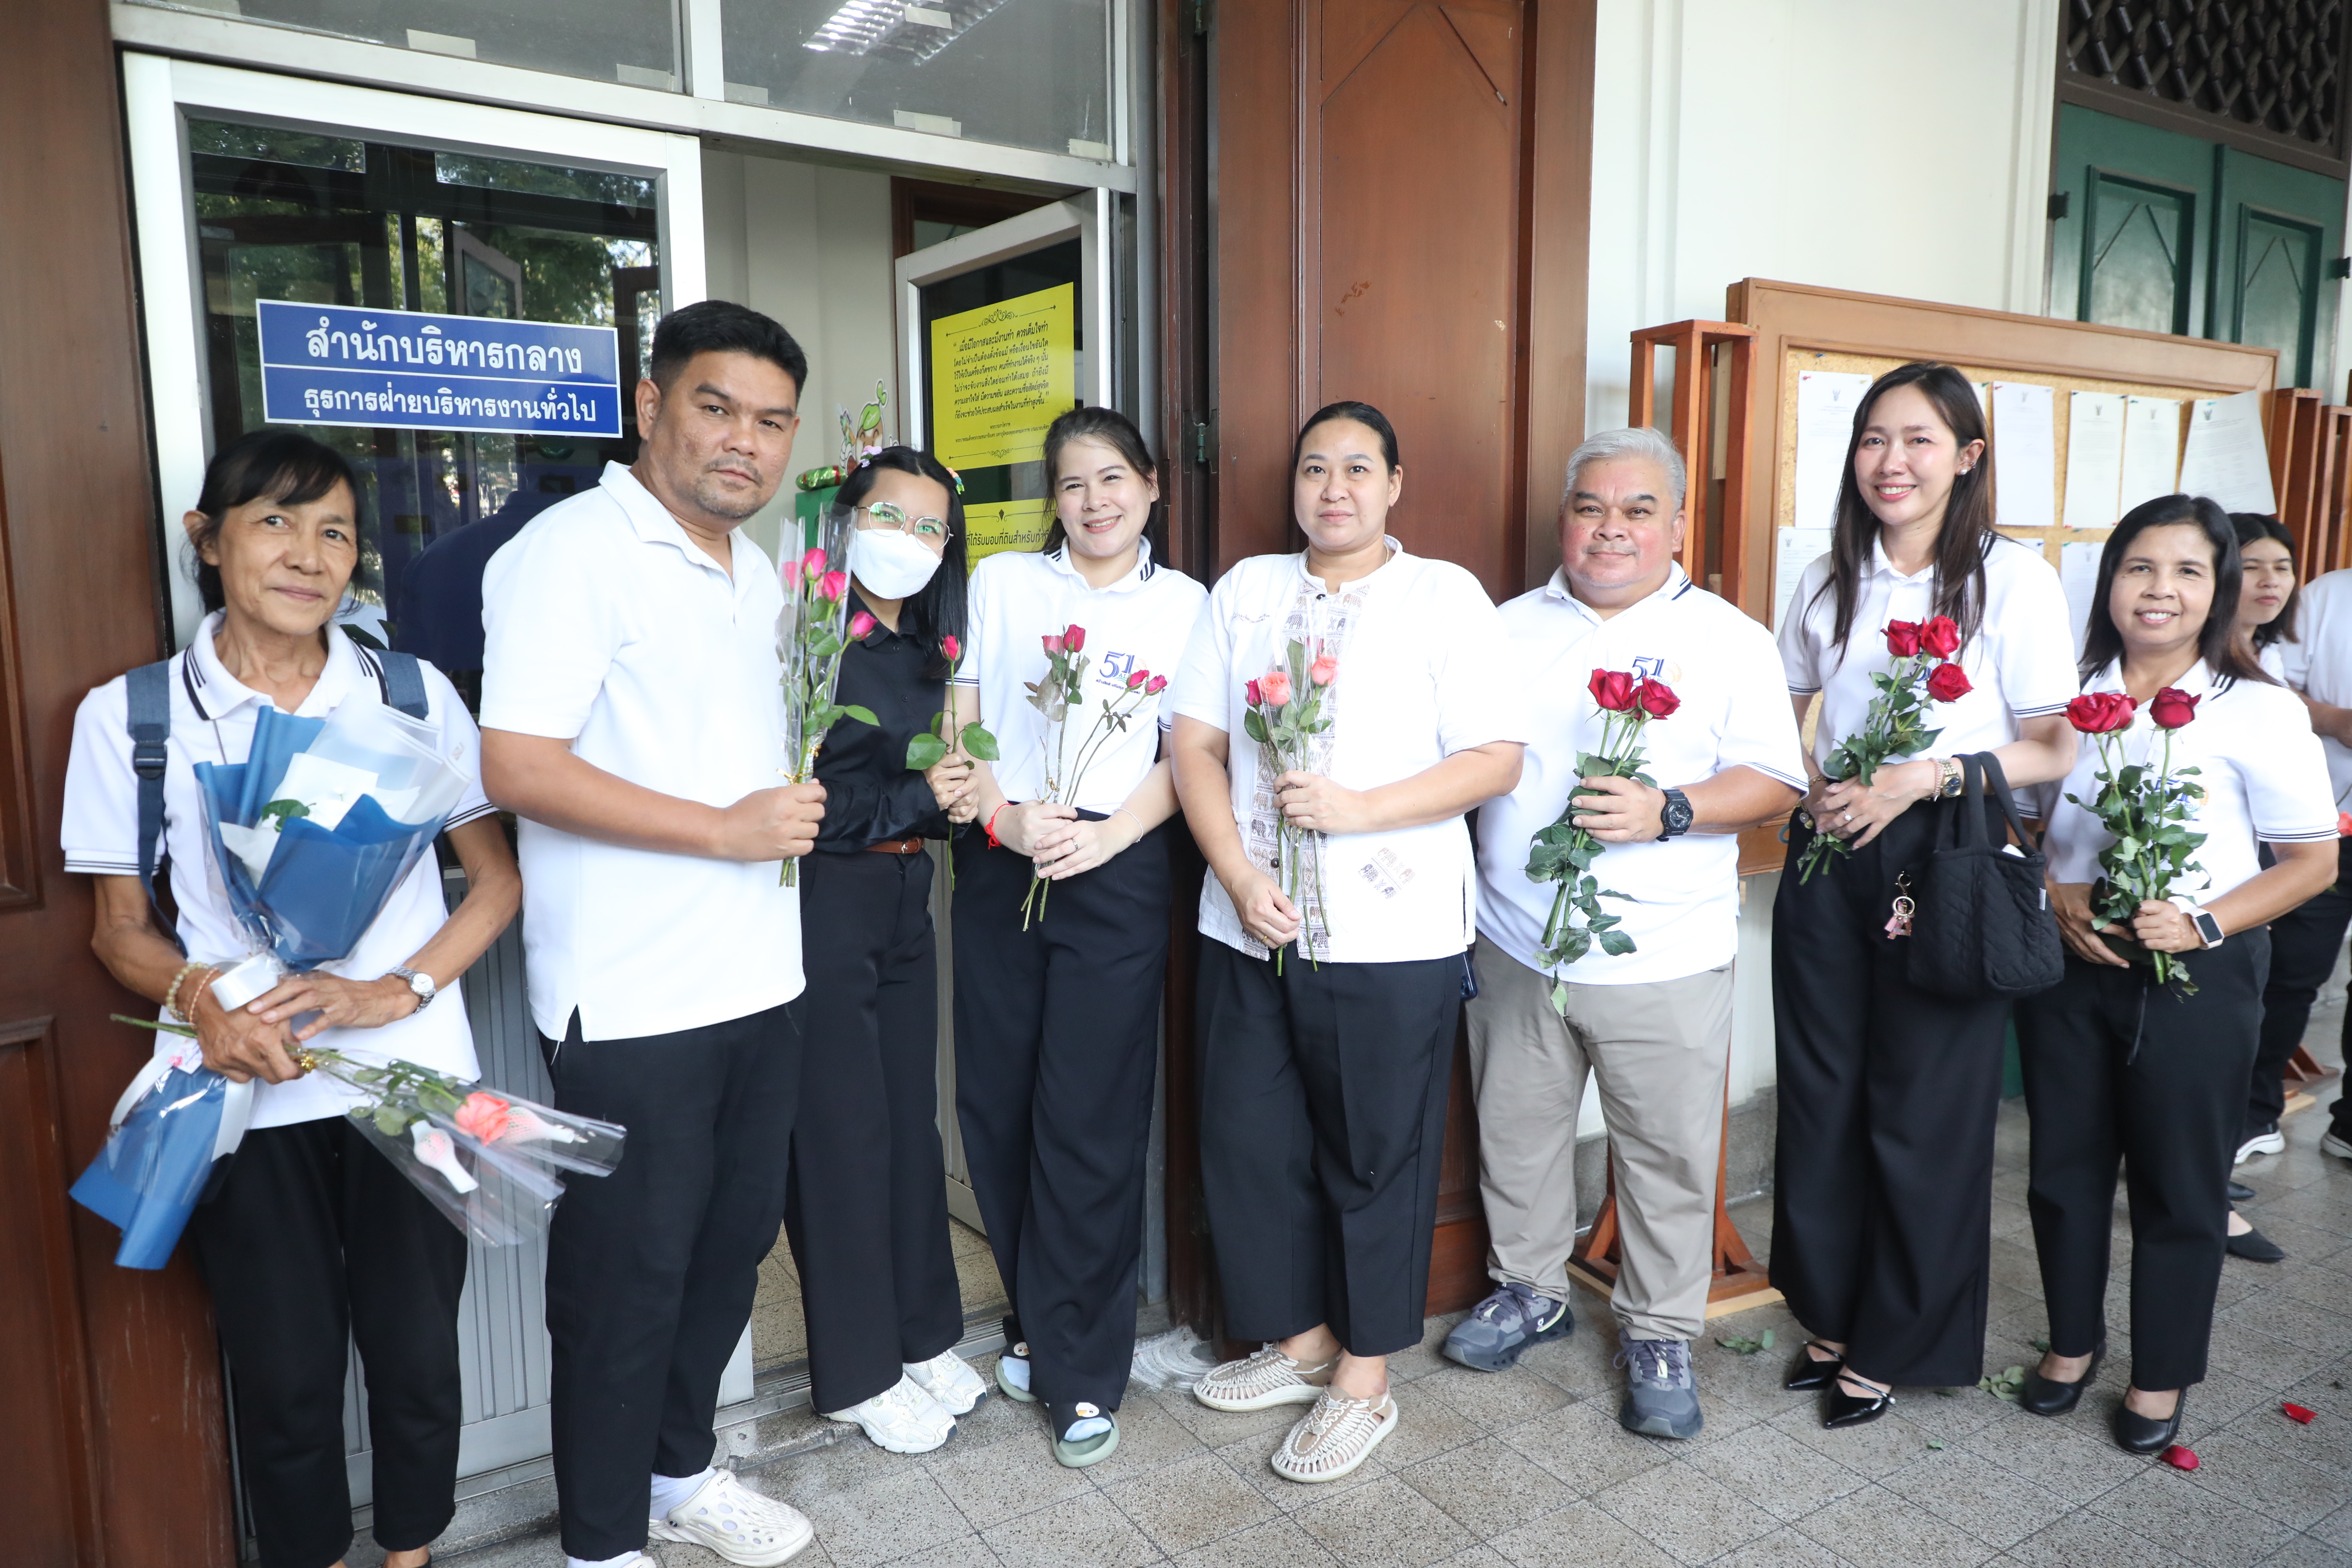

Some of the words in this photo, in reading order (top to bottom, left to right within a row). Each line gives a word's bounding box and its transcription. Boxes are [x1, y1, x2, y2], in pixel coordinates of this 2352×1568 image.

[1016, 320, 1048, 338] ควรเต็มใจทำ
[306, 316, 582, 374] สำนักบริหารกลาง
[954, 346, 1008, 367] โดยไม่จำเป็นต้องตั้งข้อแม้
[1009, 338, 1048, 354] หรือเงื่อนไขอันใด
[955, 371, 1029, 393] ไม่ว่าจะจับงานสิ่งใดย่อมทำได้เสมอ
[1032, 363, 1048, 377] ถ้ายิ่งมี
[304, 381, 596, 422] ธุรการฝ่ายบริหารงานทั่วไป
[1099, 651, 1135, 678] 51
[1632, 655, 1665, 681] 51
